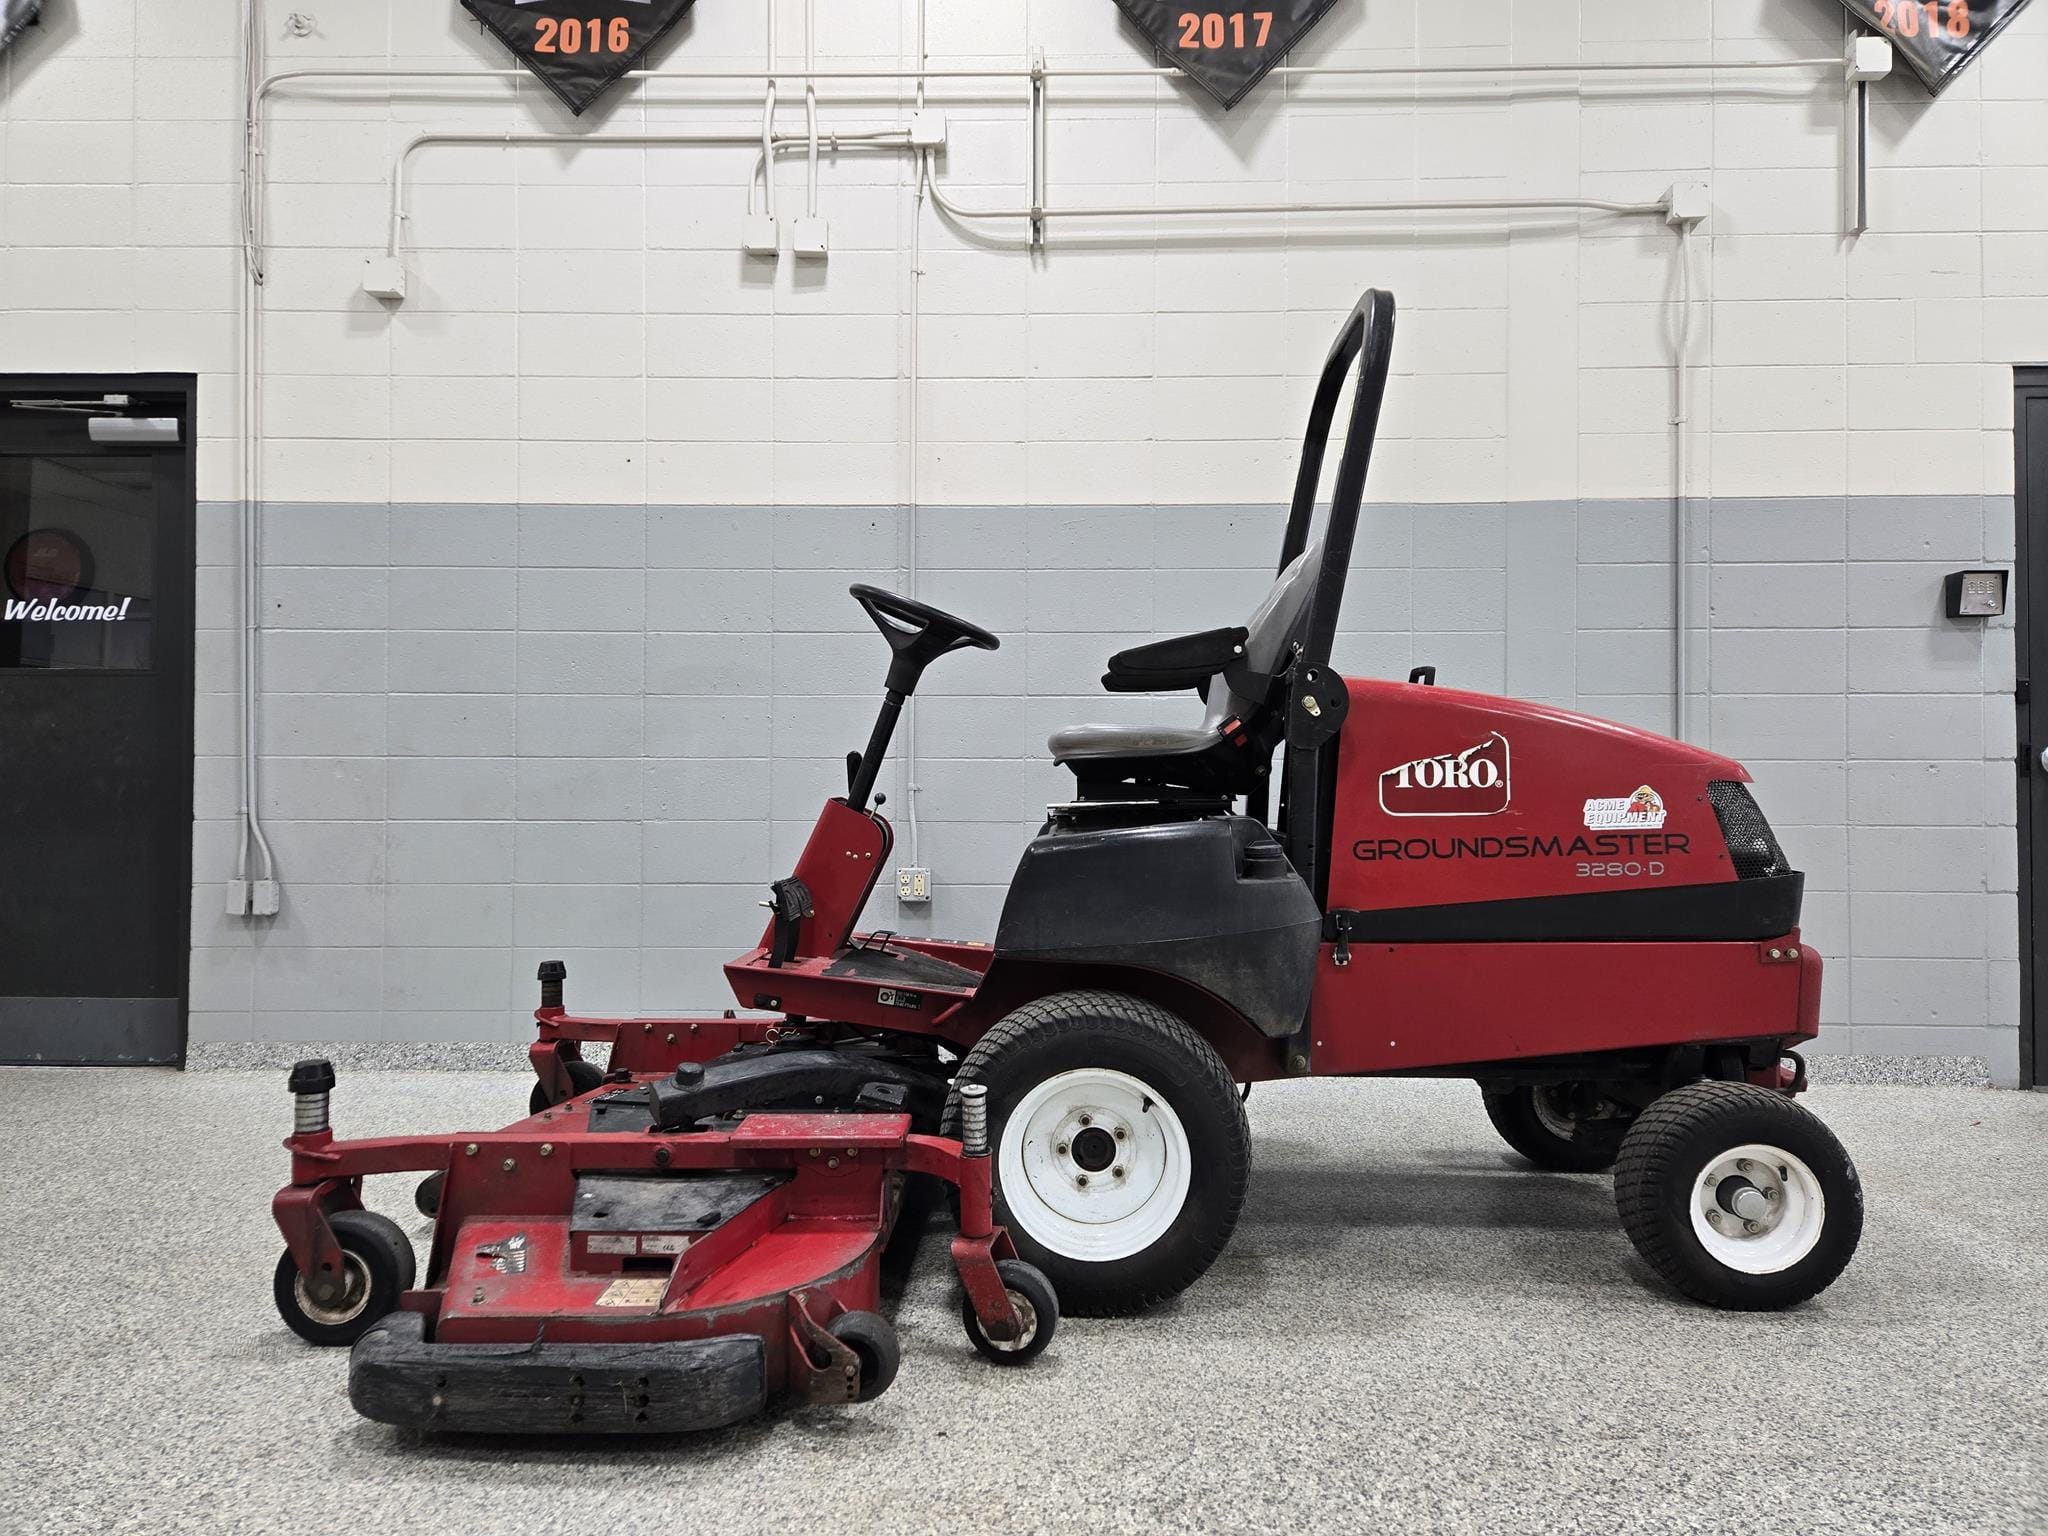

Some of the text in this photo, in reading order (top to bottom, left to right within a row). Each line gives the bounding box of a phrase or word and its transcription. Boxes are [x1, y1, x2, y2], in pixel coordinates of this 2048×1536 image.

[1178, 12, 1273, 49] 2017
[1873, 0, 1970, 38] 2018
[534, 17, 629, 54] 2016
[4, 597, 132, 621] Welcome!
[1586, 799, 1625, 811] ACME
[1586, 811, 1665, 825] EQUIPMENT
[1353, 833, 1690, 861] GROUNDSMASTER
